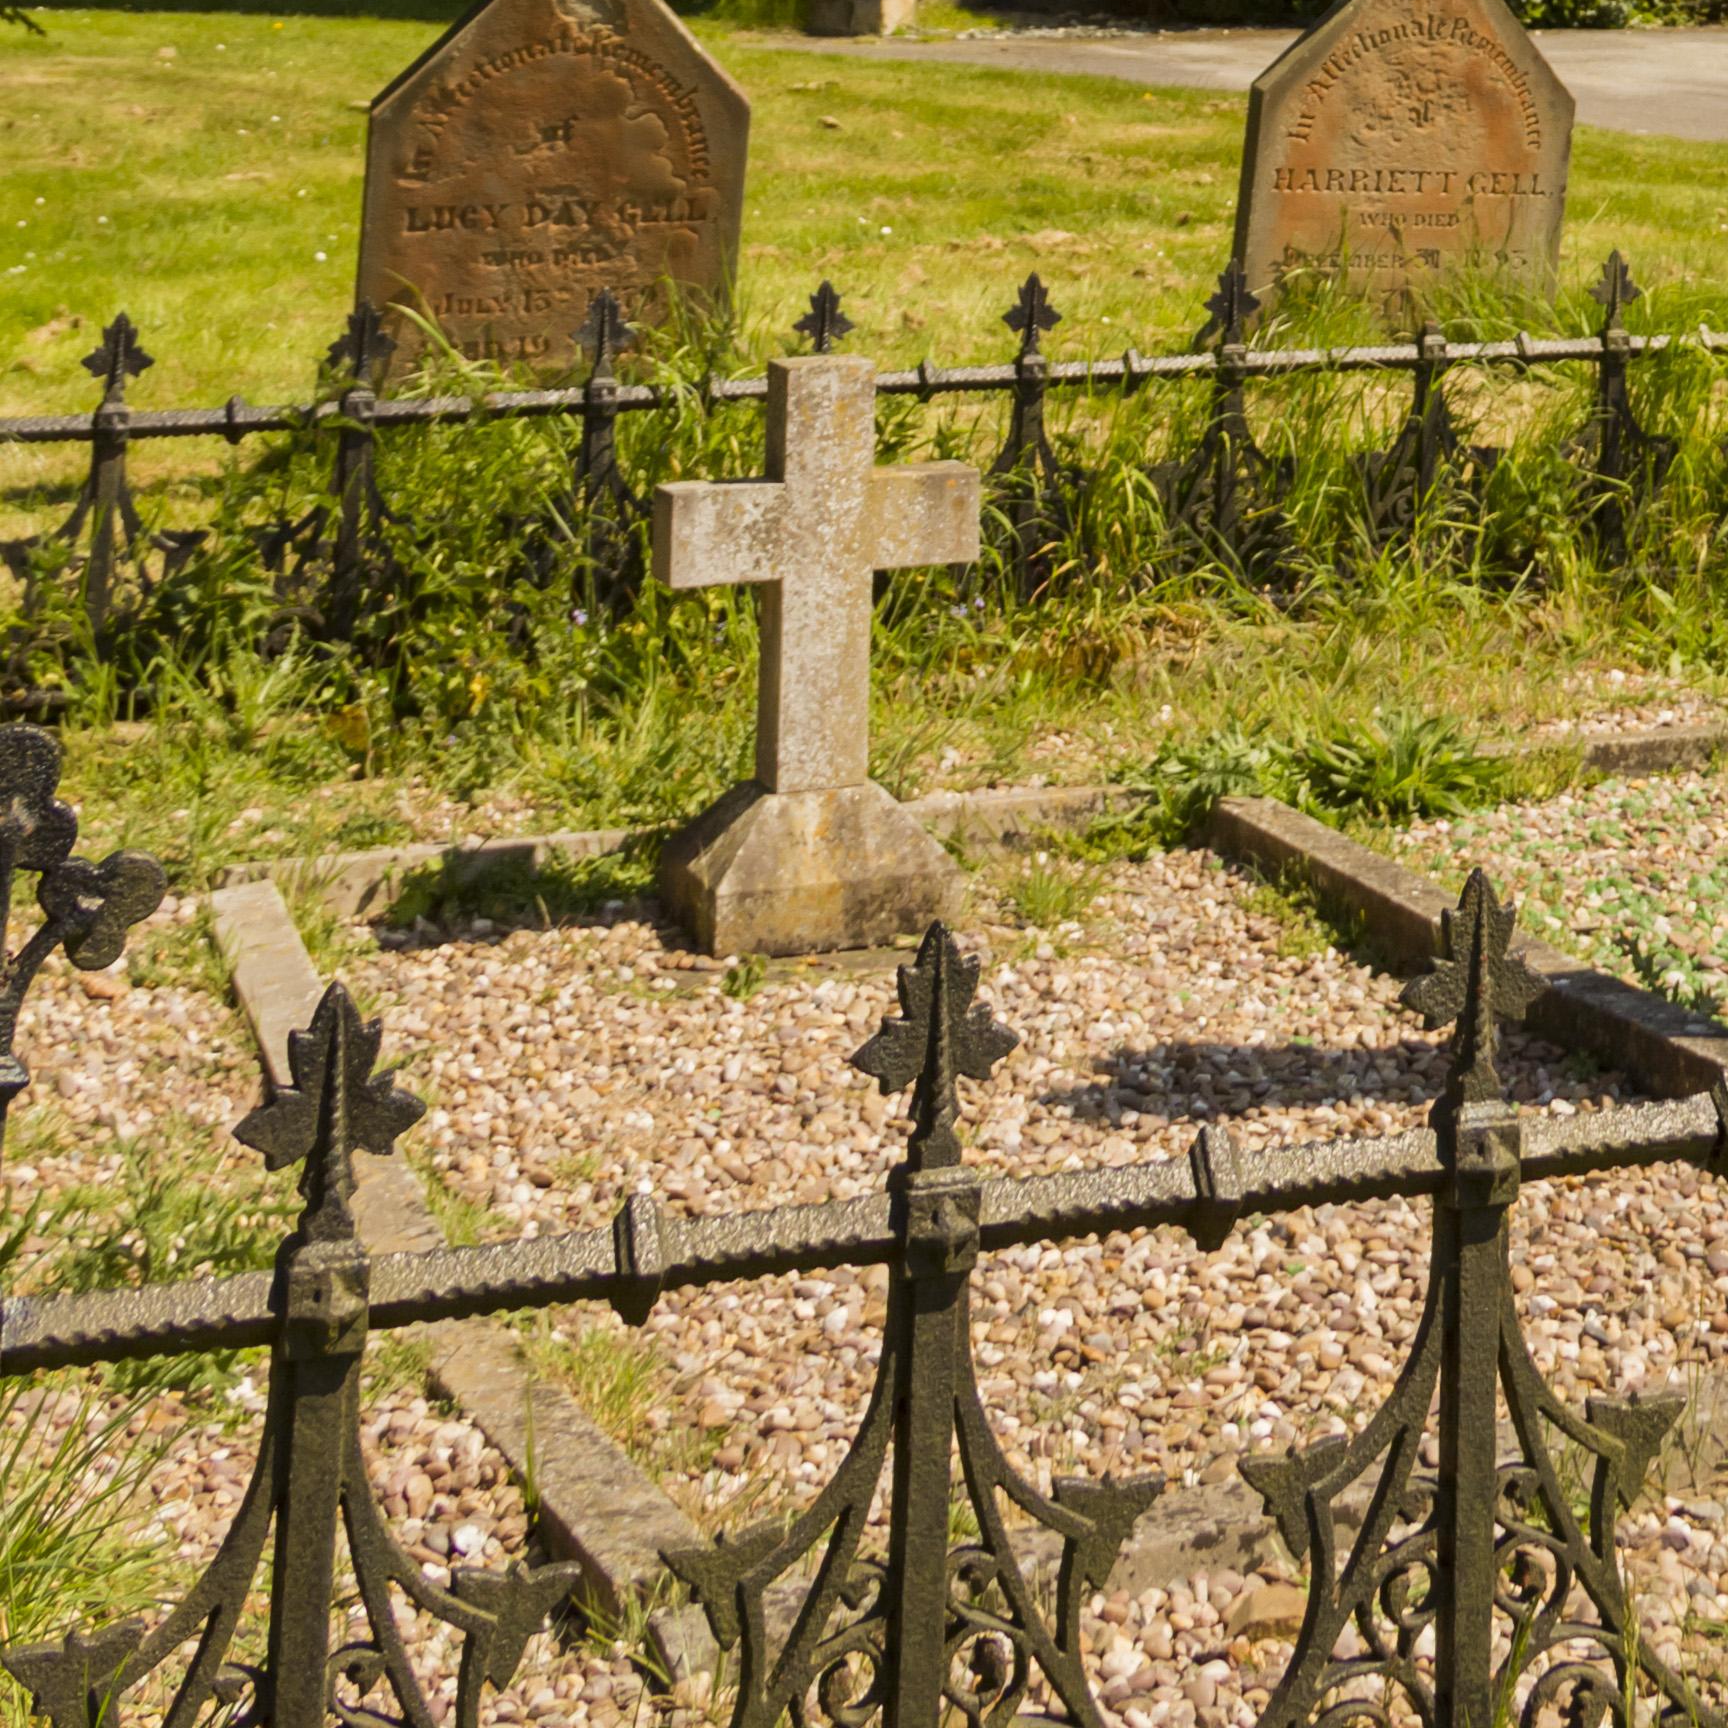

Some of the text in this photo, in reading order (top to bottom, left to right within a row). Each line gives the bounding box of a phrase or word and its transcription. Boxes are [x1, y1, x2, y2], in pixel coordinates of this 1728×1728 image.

[1272, 167, 1458, 194] HARRIETT
[1359, 212, 1461, 228] WHO DIED
